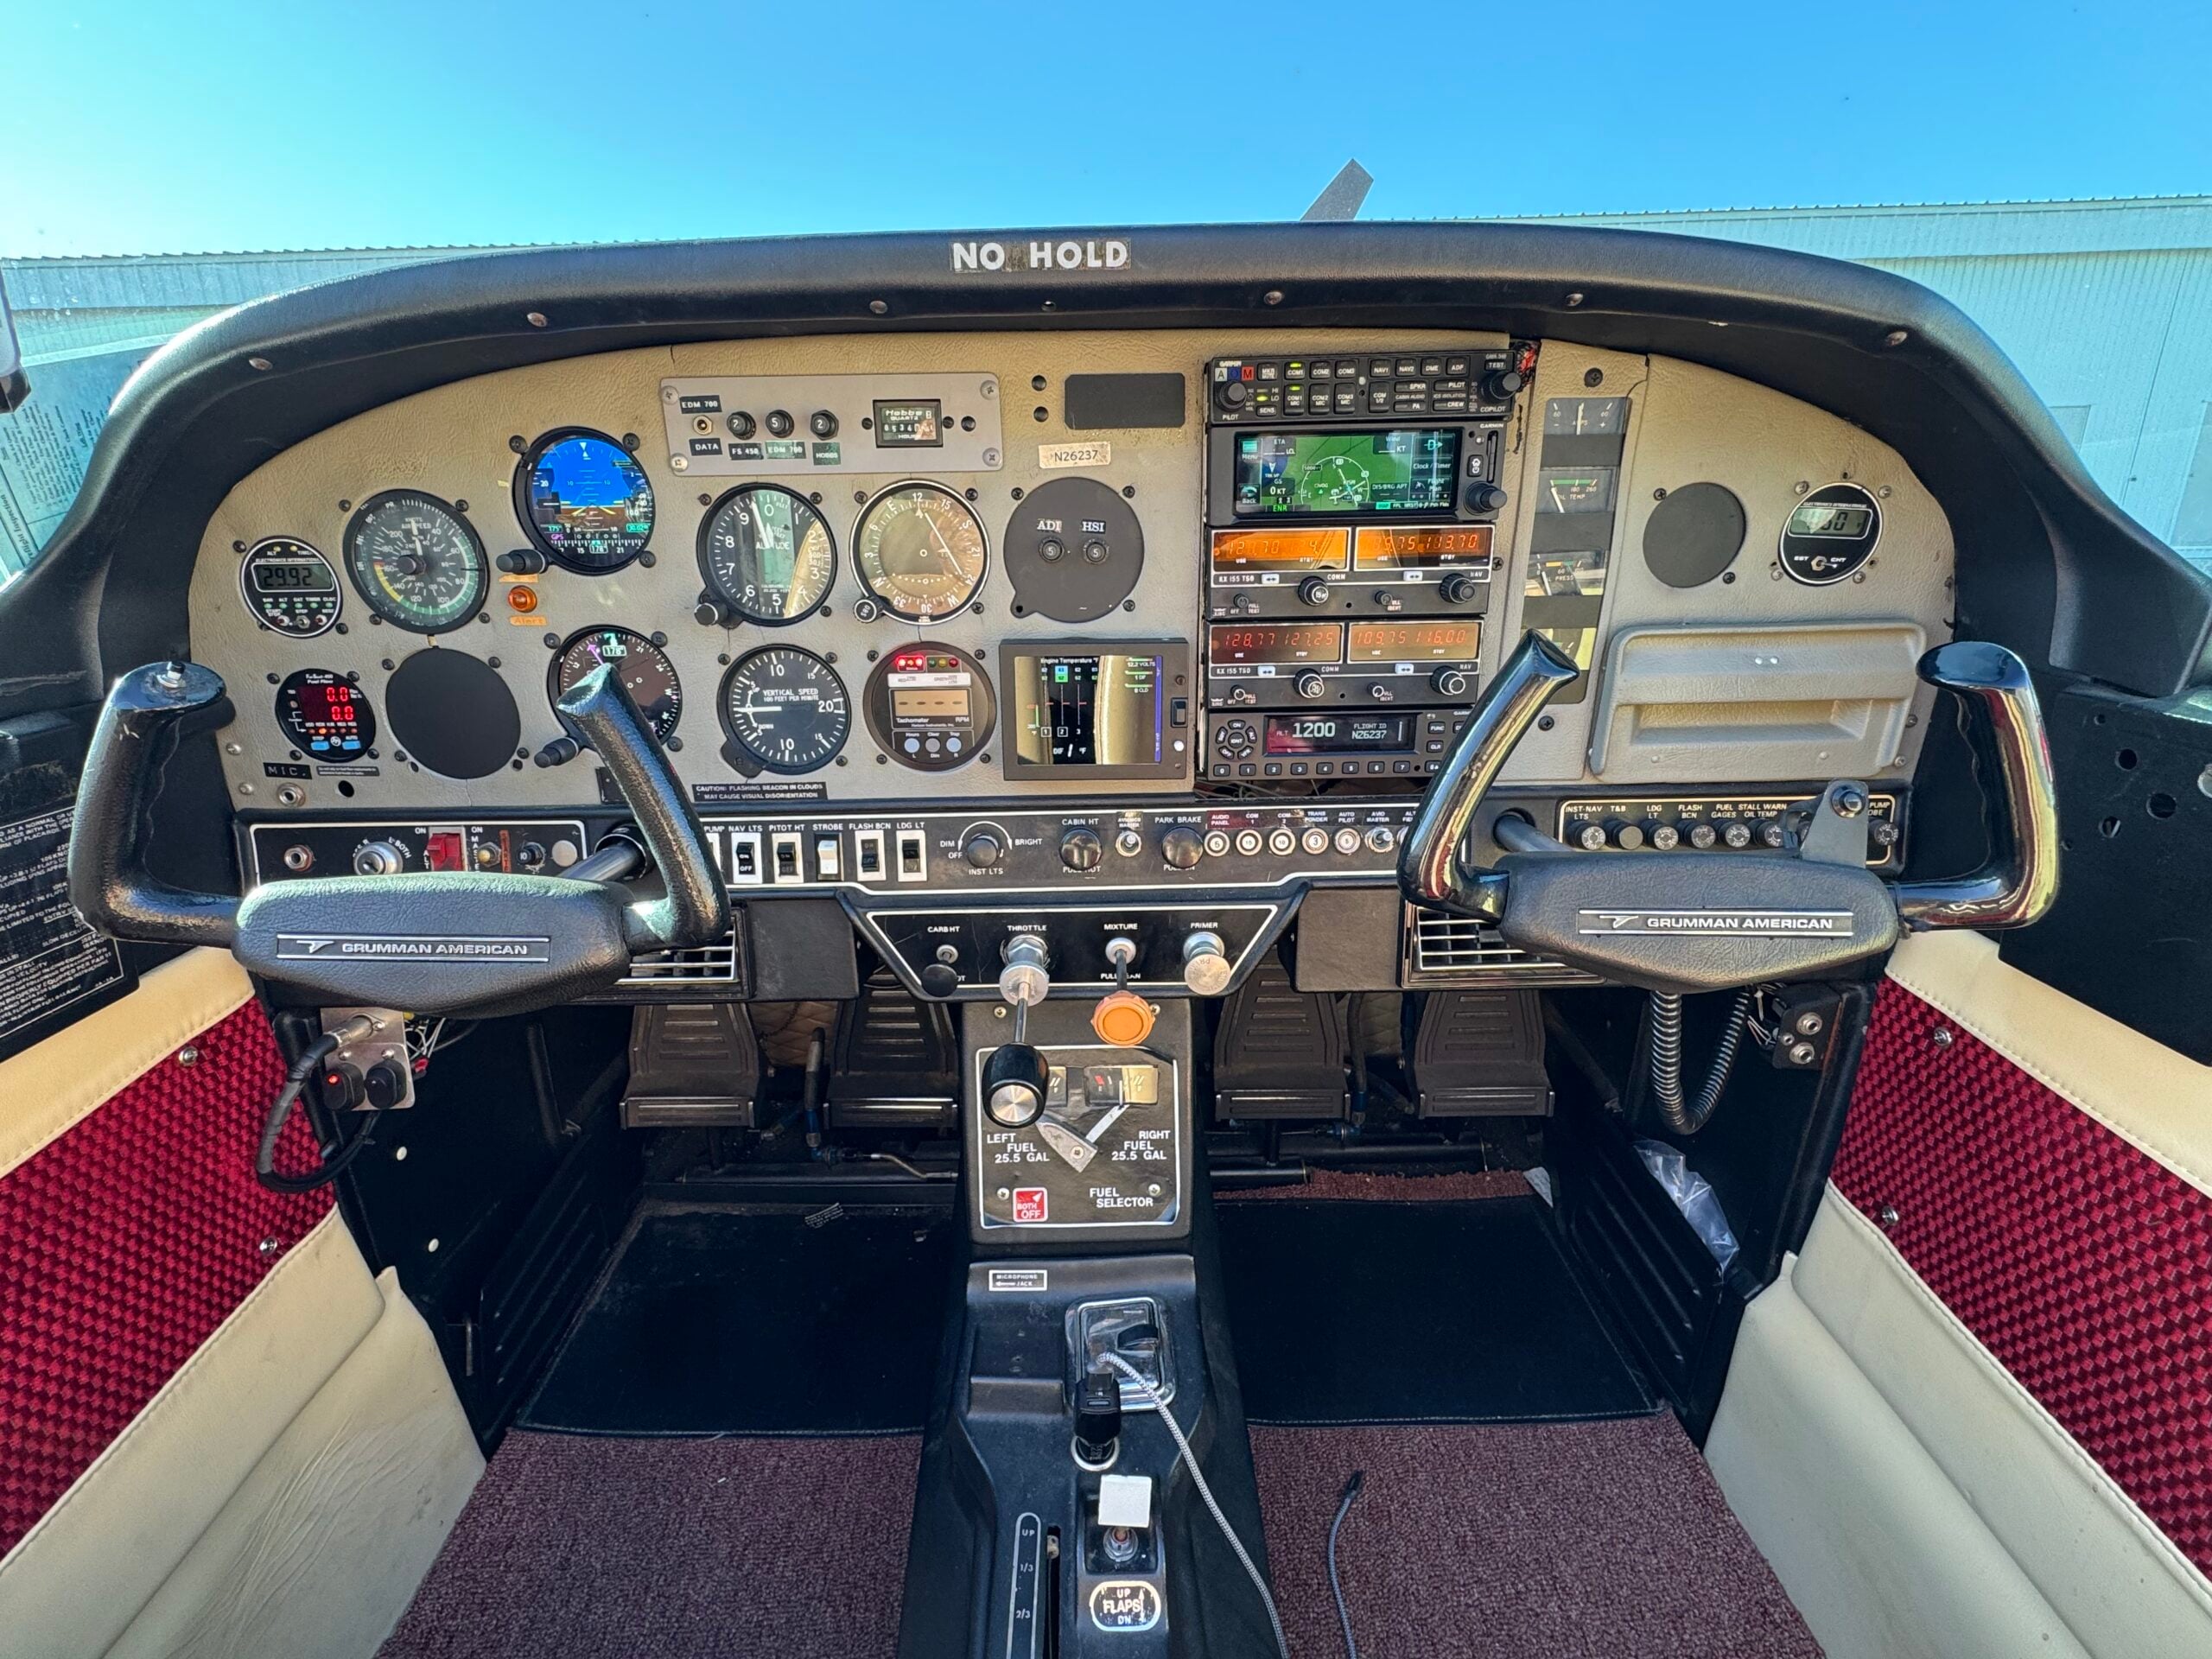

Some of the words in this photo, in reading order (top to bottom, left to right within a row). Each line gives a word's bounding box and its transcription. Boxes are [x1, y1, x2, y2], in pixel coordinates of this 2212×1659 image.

[953, 243, 1005, 270] NO
[1030, 241, 1128, 269] HOLD
[1054, 449, 1098, 461] N26237
[912, 493, 922, 502] 12
[1037, 521, 1062, 532] ADI
[1082, 522, 1104, 532] HSI
[264, 568, 311, 586] 29.92
[893, 597, 906, 608] 33
[921, 604, 932, 613] 30
[1225, 633, 1275, 648] 128.77
[1285, 632, 1333, 646] 127.25
[327, 687, 348, 702] 0.0
[818, 701, 834, 712] 20
[332, 706, 353, 720] 0.0
[1293, 721, 1336, 737] 1200
[1352, 731, 1387, 740] N26237
[25, 817, 55, 829] NORMAL
[471, 836, 480, 872] MASTE
[1647, 918, 1738, 929] GRUMMAN
[1742, 918, 1833, 930] AMERICAN
[342, 944, 431, 954] GRUMMAN
[435, 944, 527, 955] AMERICAN
[987, 1134, 1016, 1144] LEFT
[1139, 1130, 1170, 1140] RIGHT
[1007, 1142, 1037, 1153] FUEL
[1123, 1141, 1154, 1151] FUEL
[995, 1153, 1020, 1164] 25.5
[1027, 1152, 1050, 1163] GAL
[1111, 1151, 1137, 1161] 25.5
[1143, 1149, 1166, 1160] GAL
[1090, 1187, 1120, 1198] FUEL
[1096, 1198, 1154, 1208] SELECTOR
[1021, 1211, 1040, 1219] OFF
[1021, 1529, 1035, 1537] UP
[1116, 1588, 1131, 1599] UP
[1103, 1599, 1141, 1614] FLAPS
[1015, 1610, 1031, 1620] 2/3
[1117, 1615, 1131, 1625] DN
